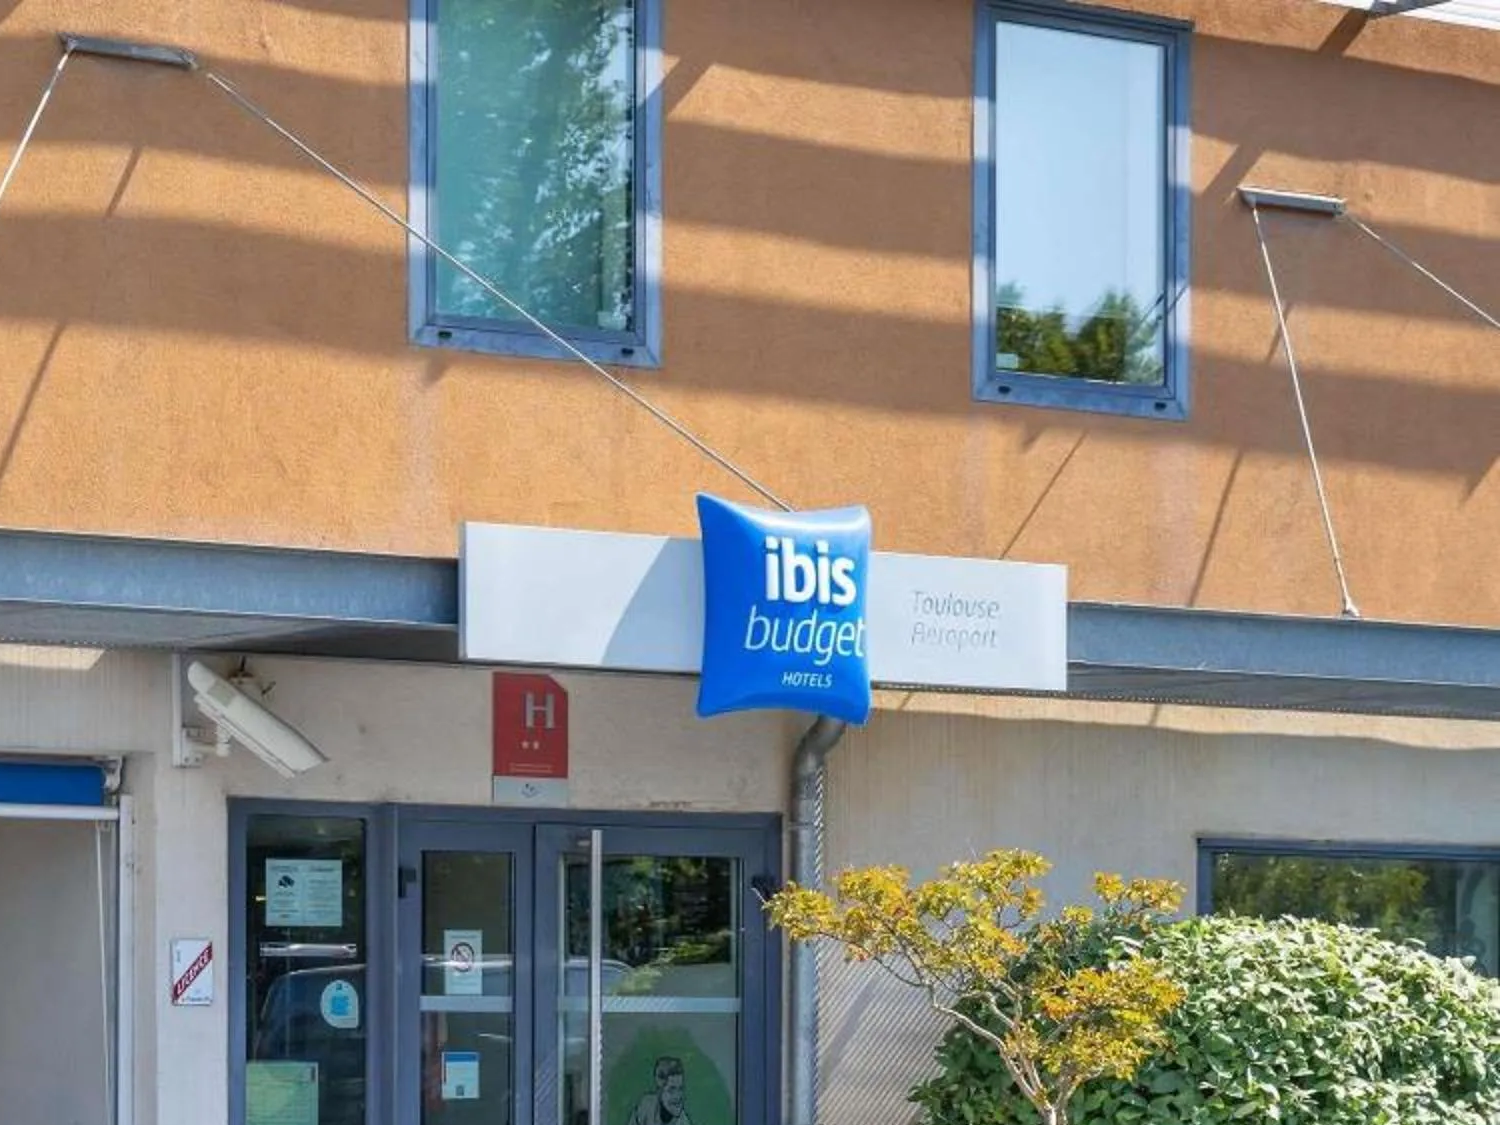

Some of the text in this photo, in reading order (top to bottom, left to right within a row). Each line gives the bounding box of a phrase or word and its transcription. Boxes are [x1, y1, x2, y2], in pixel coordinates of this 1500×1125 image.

[765, 535, 857, 606] ibis
[911, 589, 1000, 619] Toulouse
[744, 604, 866, 666] budget
[781, 671, 833, 689] HOTELS
[524, 691, 555, 729] H
[175, 948, 210, 996] LICENCE
